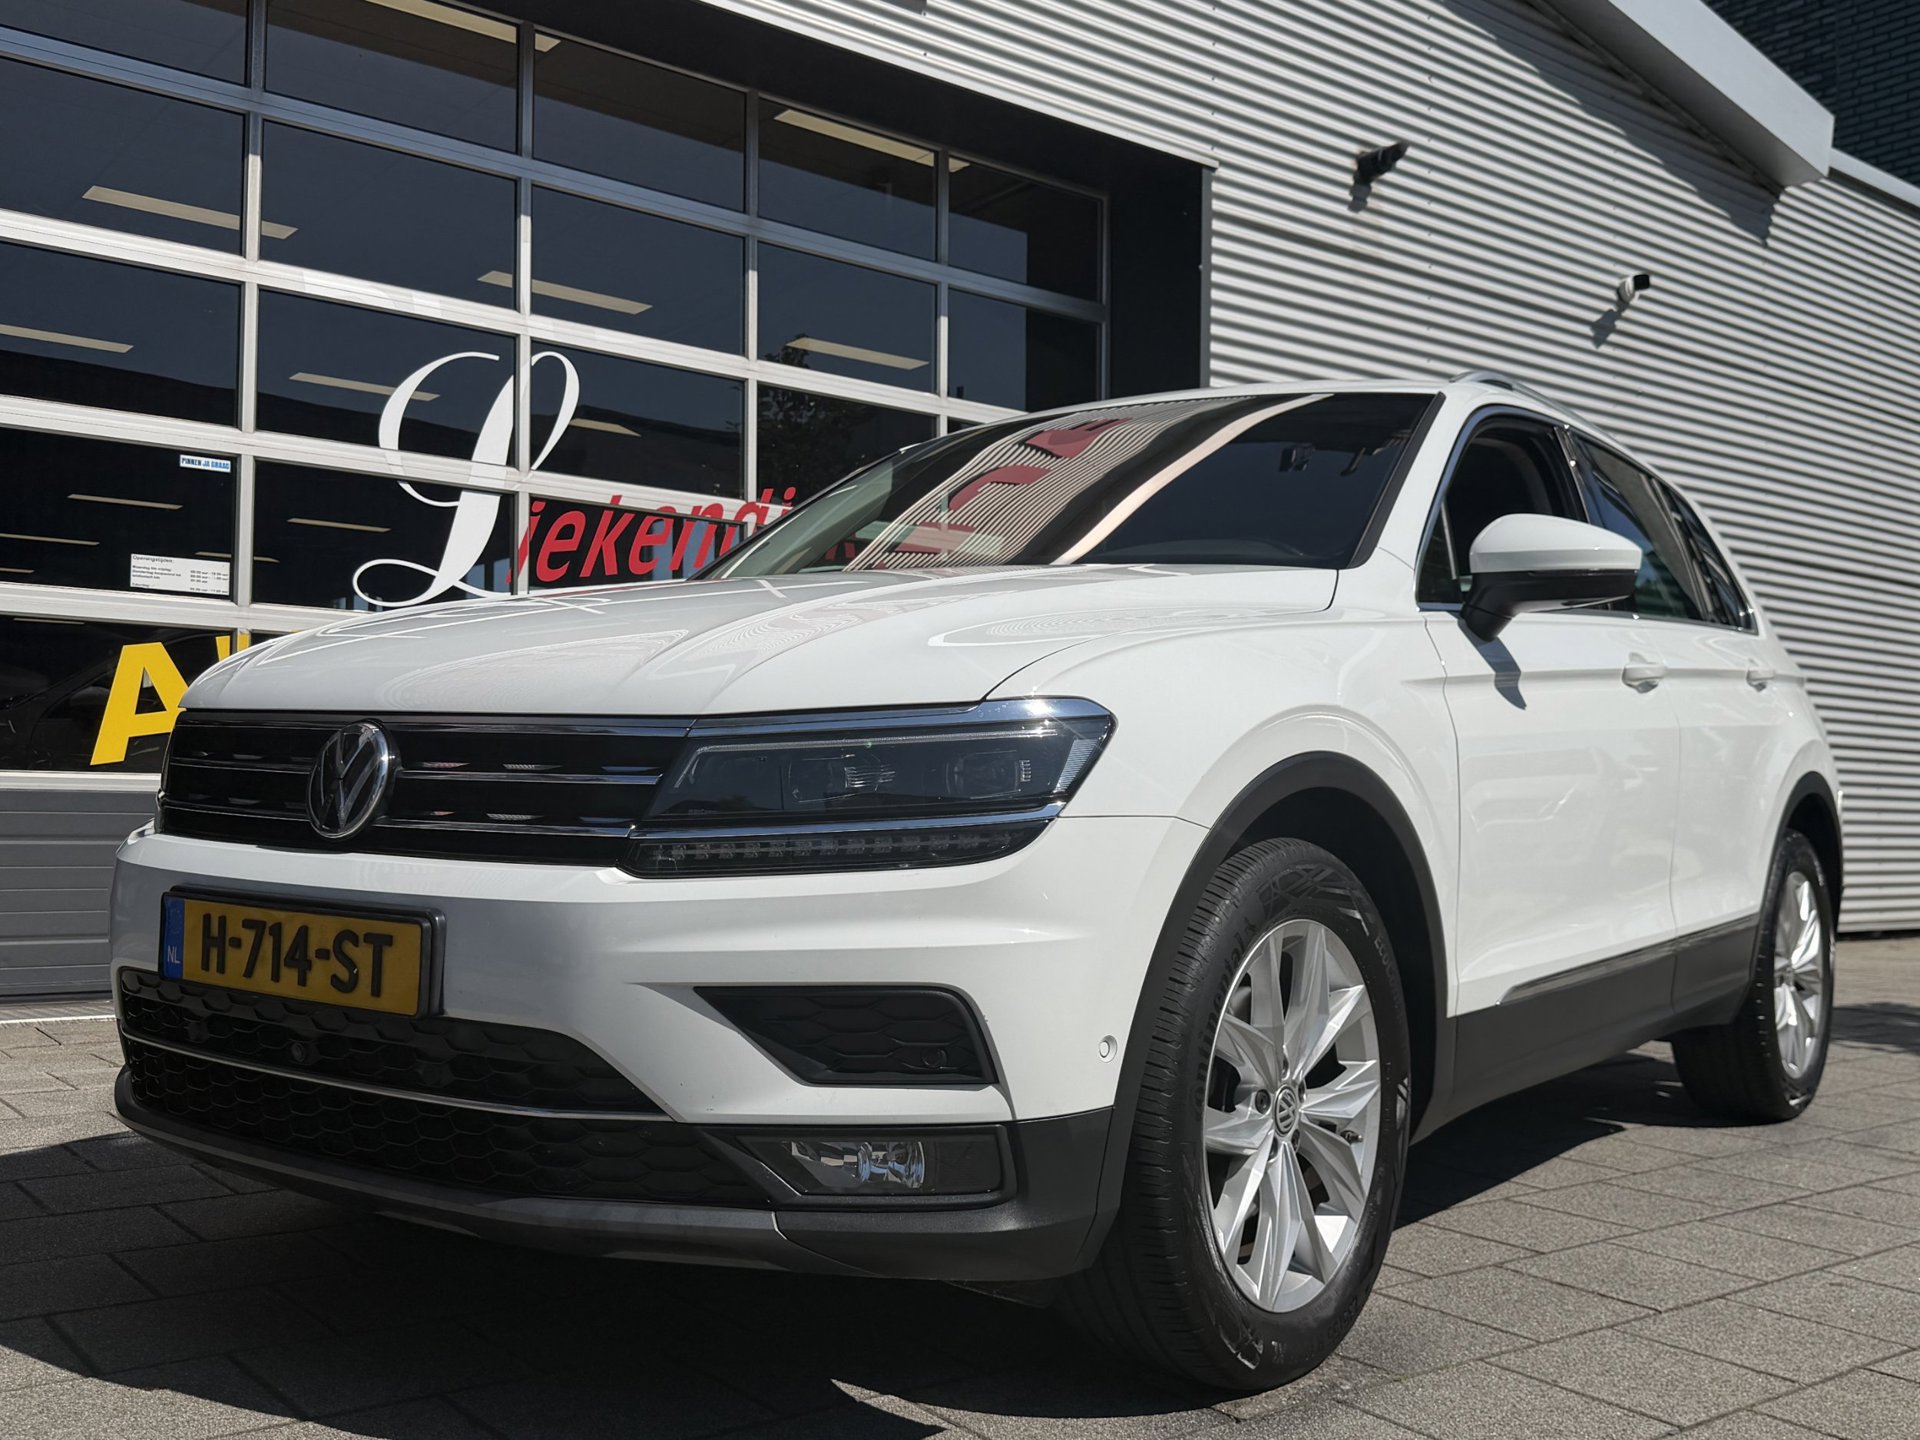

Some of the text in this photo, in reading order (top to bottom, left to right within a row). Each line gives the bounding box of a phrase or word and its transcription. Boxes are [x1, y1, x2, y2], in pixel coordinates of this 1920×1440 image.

[203, 459, 210, 467] JA
[167, 913, 393, 998] NL H-714-ST
